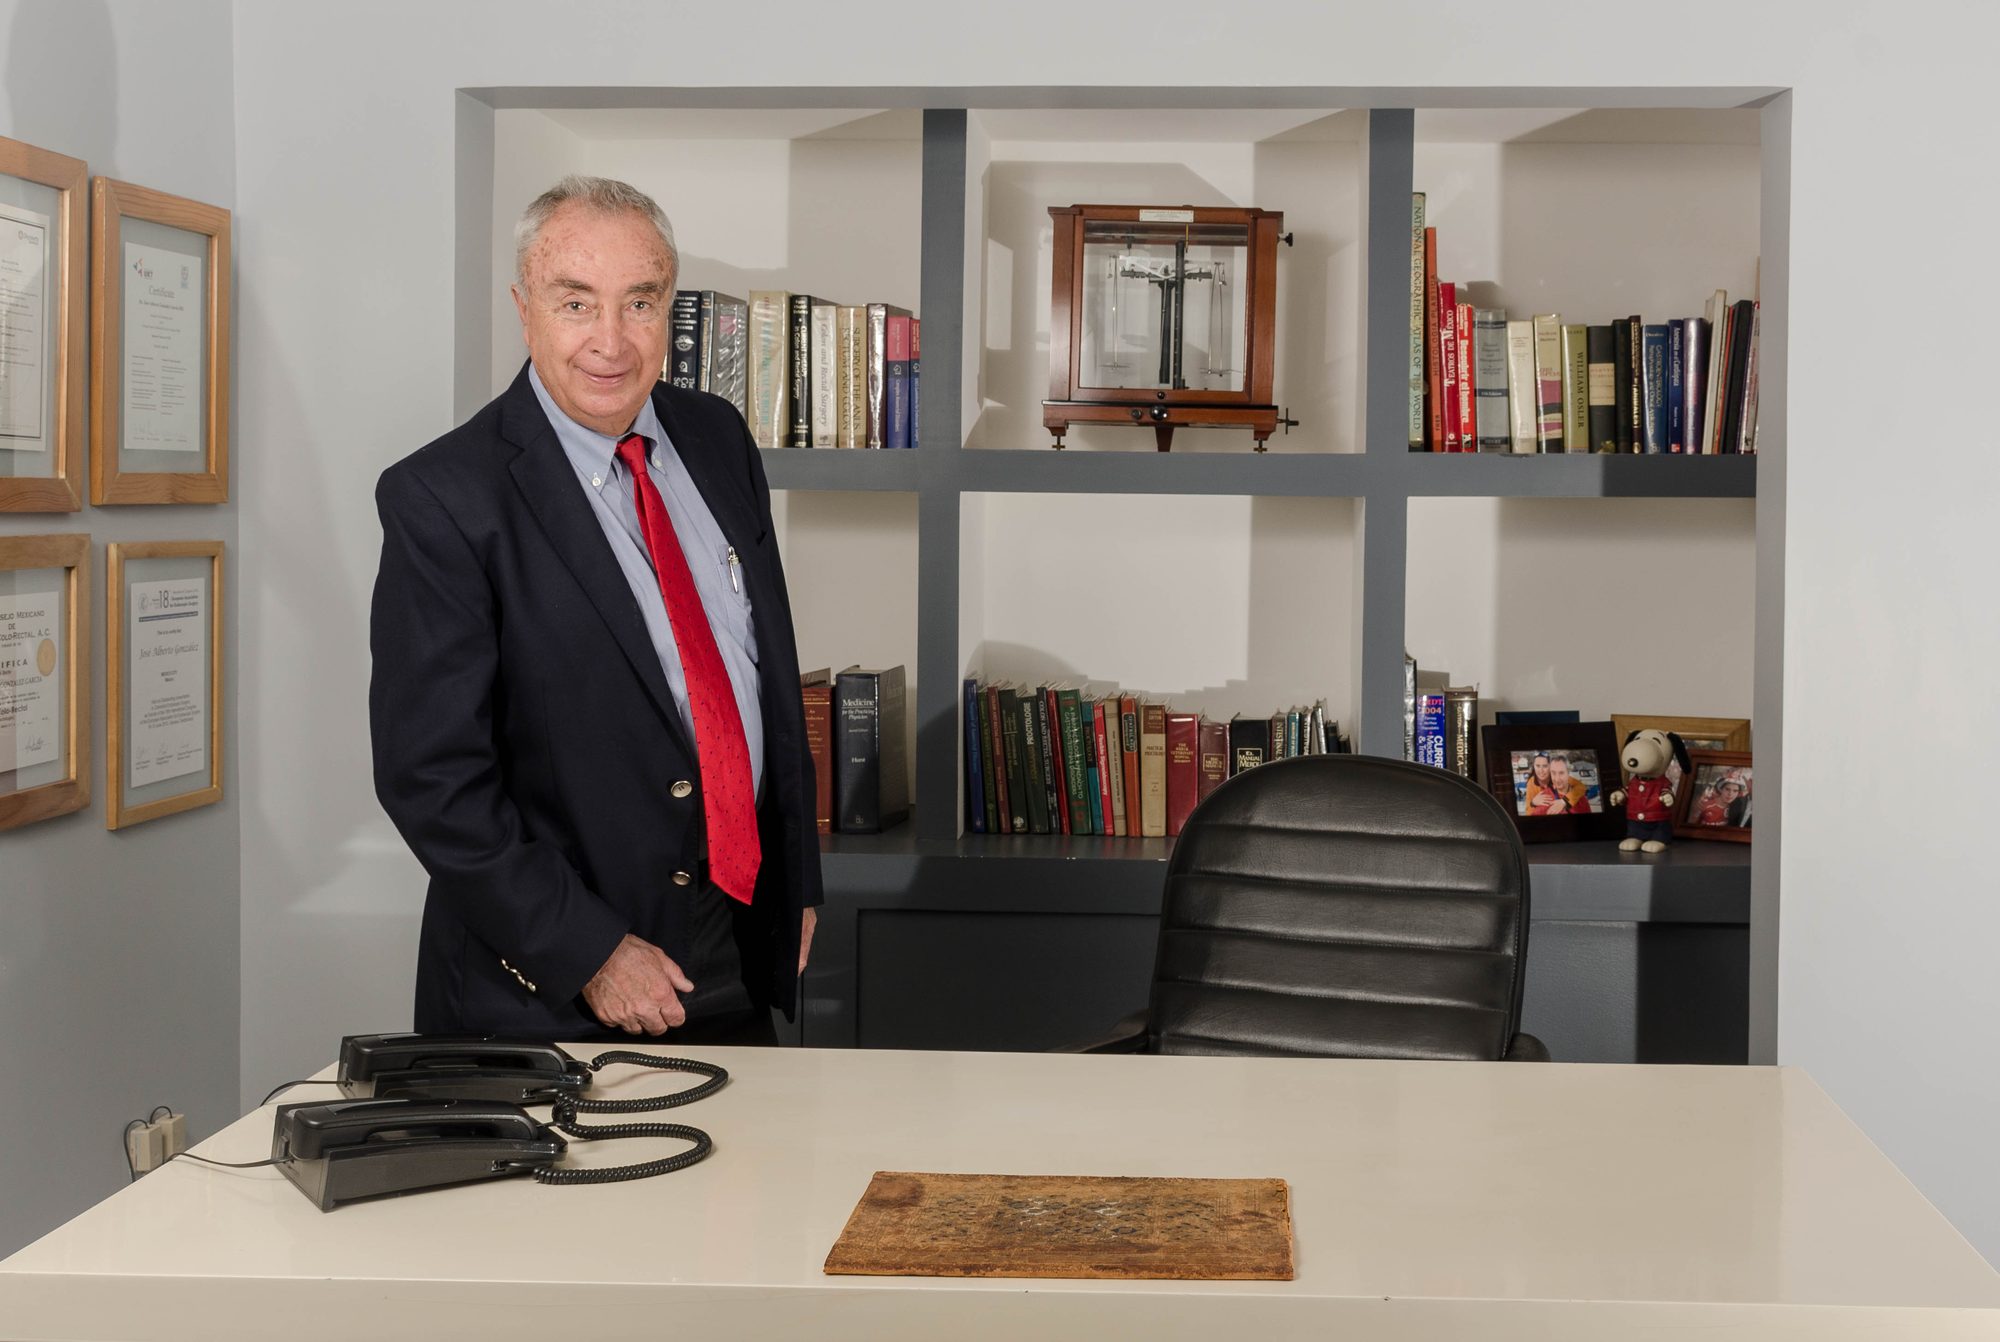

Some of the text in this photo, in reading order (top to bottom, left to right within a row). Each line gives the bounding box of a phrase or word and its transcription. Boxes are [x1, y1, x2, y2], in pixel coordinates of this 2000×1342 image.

[1413, 206, 1422, 255] NATIONAL
[1413, 258, 1422, 321] GEOGRAPHIC
[853, 327, 861, 366] SURGERY
[1413, 326, 1422, 354] ATLAS
[1448, 340, 1455, 351] DE
[853, 367, 861, 381] OF
[1413, 356, 1422, 369] OF
[1444, 353, 1455, 387] TEATROS
[1460, 339, 1469, 381] Descubrir
[818, 323, 830, 427] Colon and Rectal Surgery
[853, 383, 861, 401] THE
[1576, 351, 1585, 428] WILLIAM OSLER
[1413, 395, 1422, 431] WORLD
[1460, 391, 1470, 423] hombre
[159, 590, 170, 609] 18
[8, 623, 16, 631] DE
[17, 610, 45, 618] MEXICANO
[842, 698, 875, 707] Medicine
[1037, 700, 1046, 720] COLON
[1023, 702, 1035, 745] PROCTOLOGIE
[1039, 721, 1047, 735] AND
[1273, 721, 1284, 755] INTESTINAL
[1418, 736, 1426, 745] &
[1426, 735, 1434, 763] Medical
